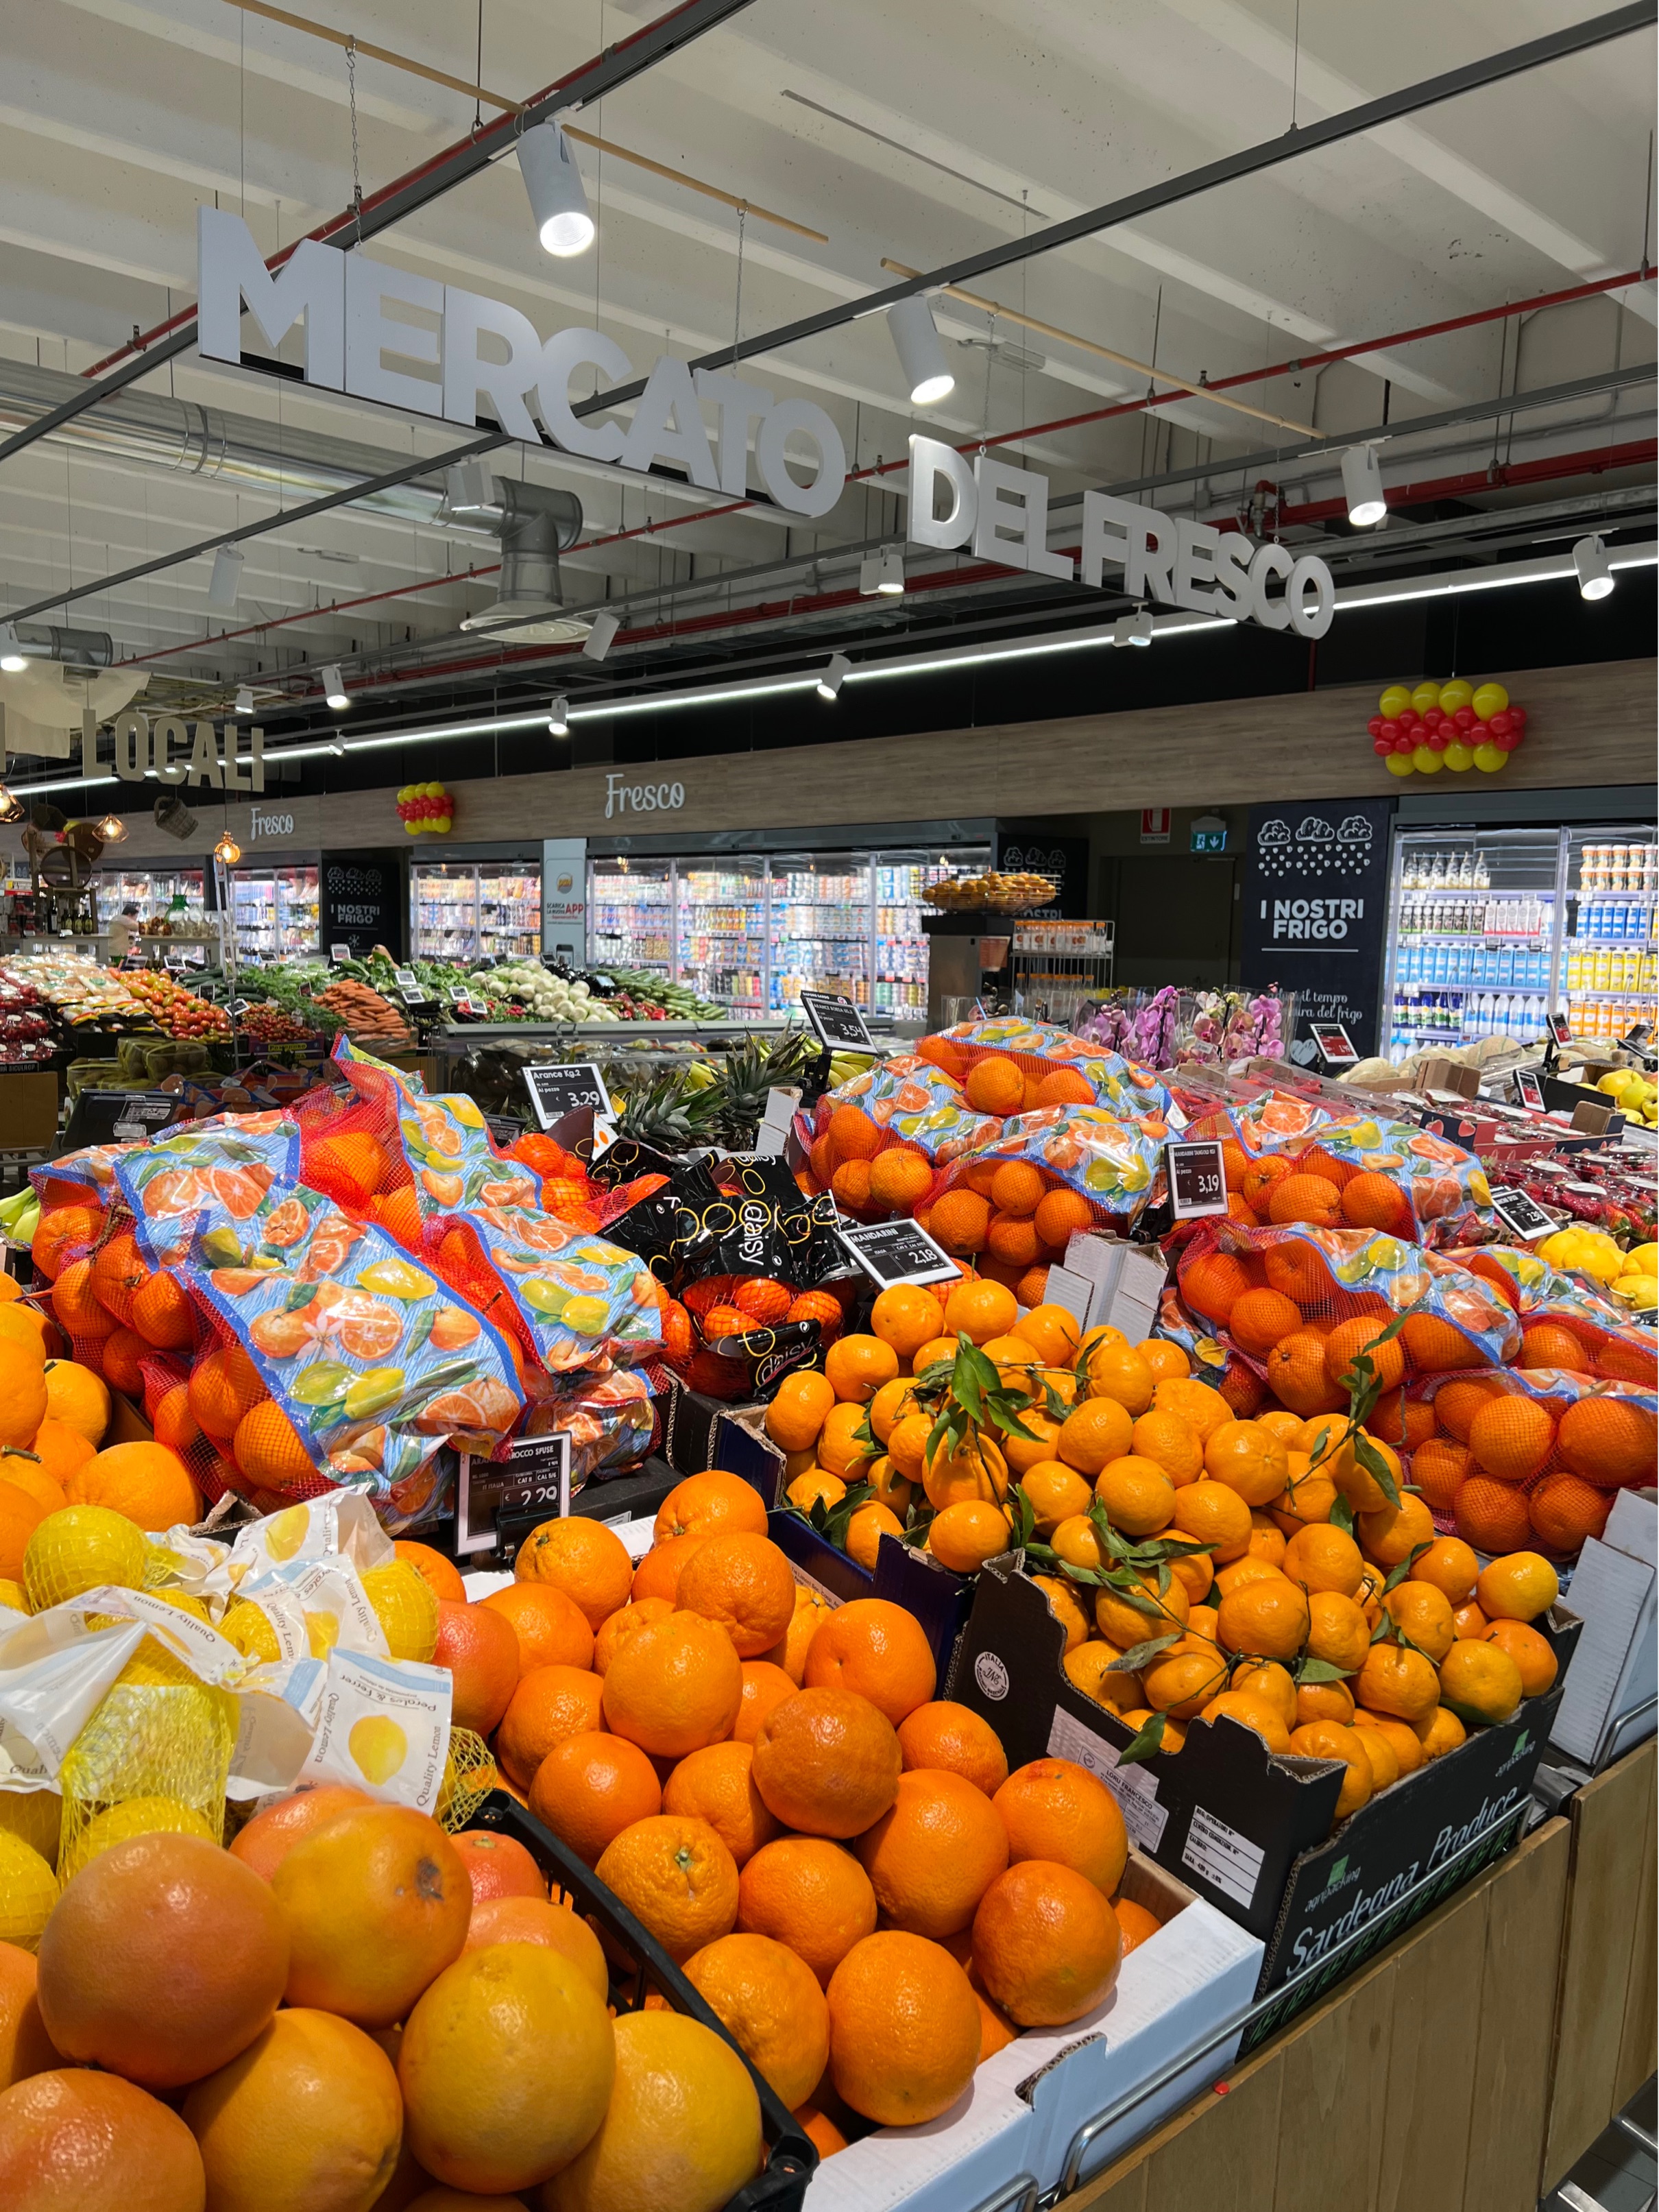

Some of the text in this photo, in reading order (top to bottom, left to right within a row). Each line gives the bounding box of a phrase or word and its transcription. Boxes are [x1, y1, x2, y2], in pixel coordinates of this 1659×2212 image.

[197, 205, 846, 518] MERCATO
[908, 433, 1335, 640] DEL FRESCO
[82, 709, 265, 793] LOCALI
[605, 773, 686, 819] Fresco
[251, 807, 294, 841] Fresco
[330, 904, 380, 915] I NOSTRI
[337, 914, 374, 924] FRIGO
[566, 903, 583, 915] APP
[1261, 898, 1364, 919] I NOSTRI
[1273, 919, 1348, 939] FRIGO
[1302, 988, 1311, 1002] il
[1313, 991, 1348, 1009] tempo
[1317, 1005, 1335, 1019] del
[1337, 1005, 1363, 1025] frigo
[840, 1023, 865, 1038] 3,54
[533, 1069, 581, 1079] Arance Kg.2
[1198, 1174, 1220, 1194] 3,19
[739, 1206, 768, 1266] daisy
[849, 1227, 899, 1243] MANDARINI
[908, 1249, 938, 1264] 2,18
[509, 1450, 534, 1460] ROCCO
[535, 1445, 554, 1456] SFUSE
[345, 1578, 361, 1607] Lemon
[134, 1596, 215, 1643] Quality Lemon
[267, 1602, 295, 1660] Quality Lem
[984, 1653, 1004, 1672] ITALIA
[340, 1674, 436, 1711] Perales & Ferrer
[314, 1692, 339, 1763] Quality Lemon
[416, 1726, 441, 1807] Quality Lemon
[1106, 1770, 1121, 1783] LORU
[1122, 1782, 1152, 1810] FRANCESCO
[1426, 1786, 1517, 1873] Produce
[1305, 1866, 1361, 1913] agripacking
